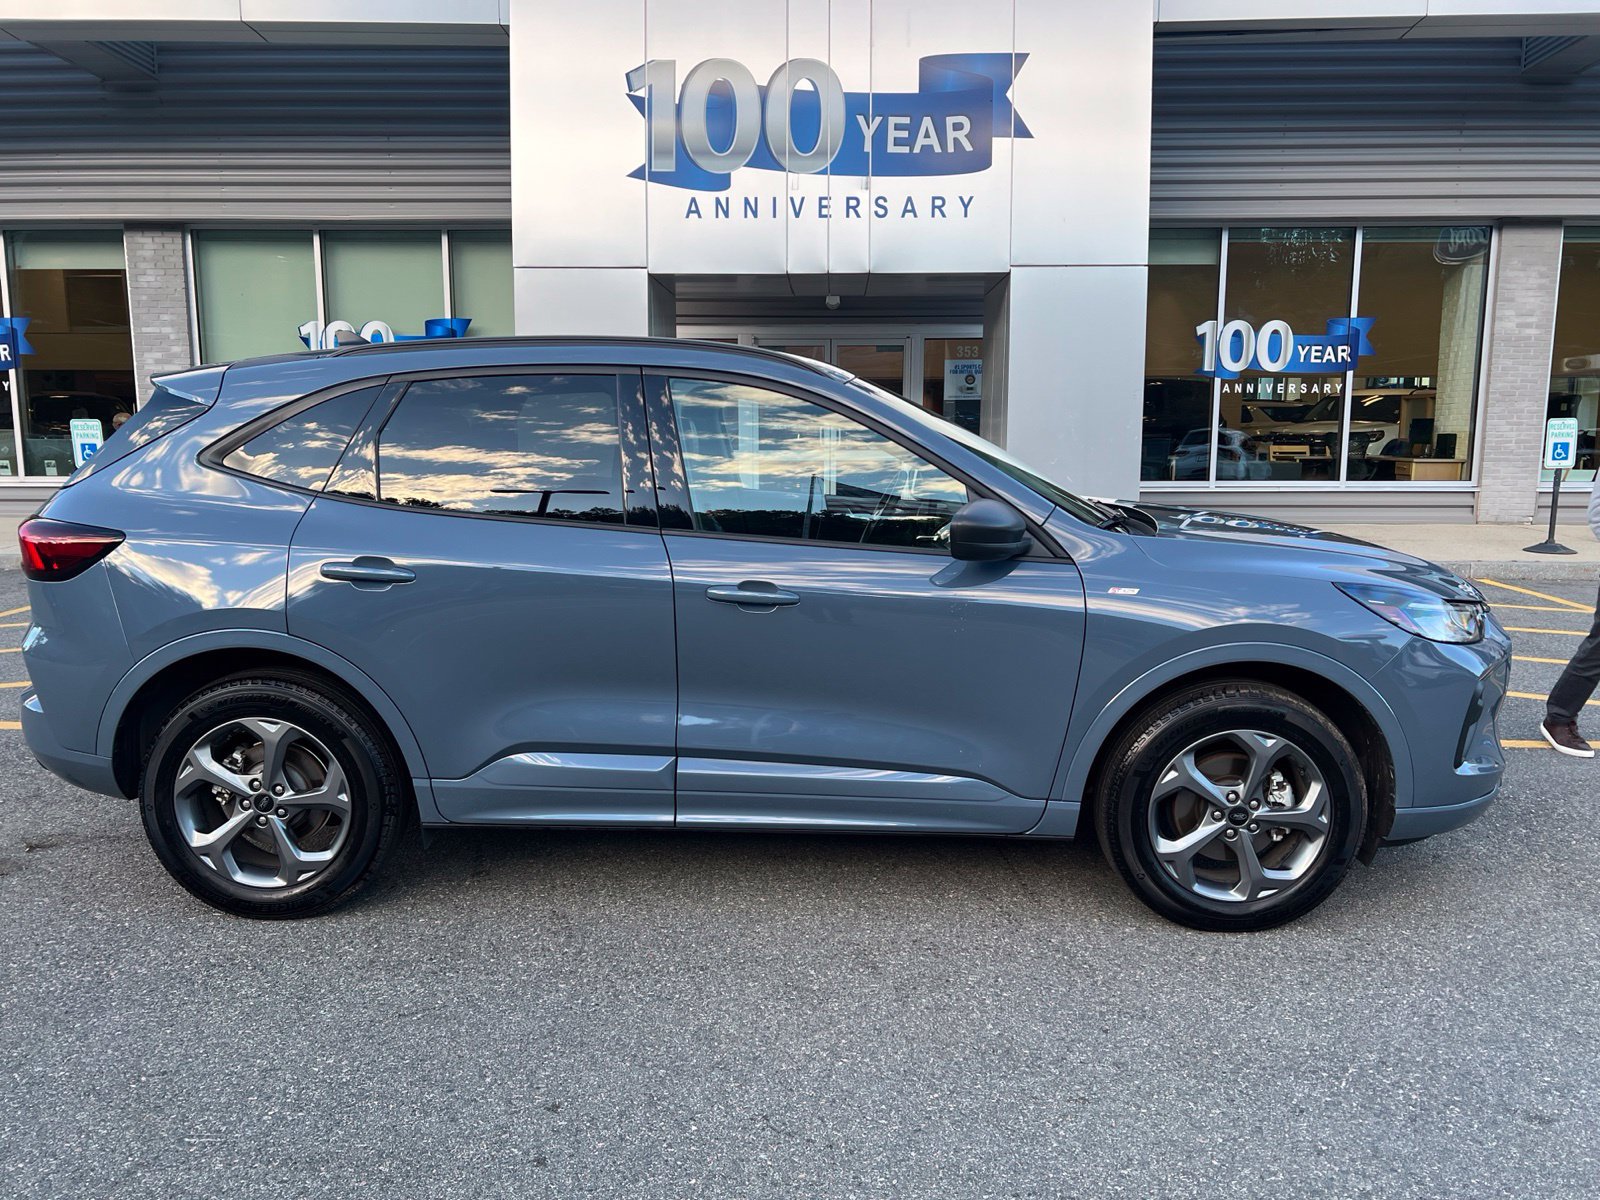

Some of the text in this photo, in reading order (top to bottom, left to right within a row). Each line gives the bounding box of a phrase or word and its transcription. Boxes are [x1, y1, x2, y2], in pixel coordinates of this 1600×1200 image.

[625, 57, 974, 174] 100 YEAR
[685, 195, 975, 219] ANNIVERSARY
[956, 345, 979, 358] 353
[1195, 319, 1352, 372] 100 YEAR
[1222, 383, 1344, 394] ANNIVERSARY
[75, 432, 99, 440] PARKING
